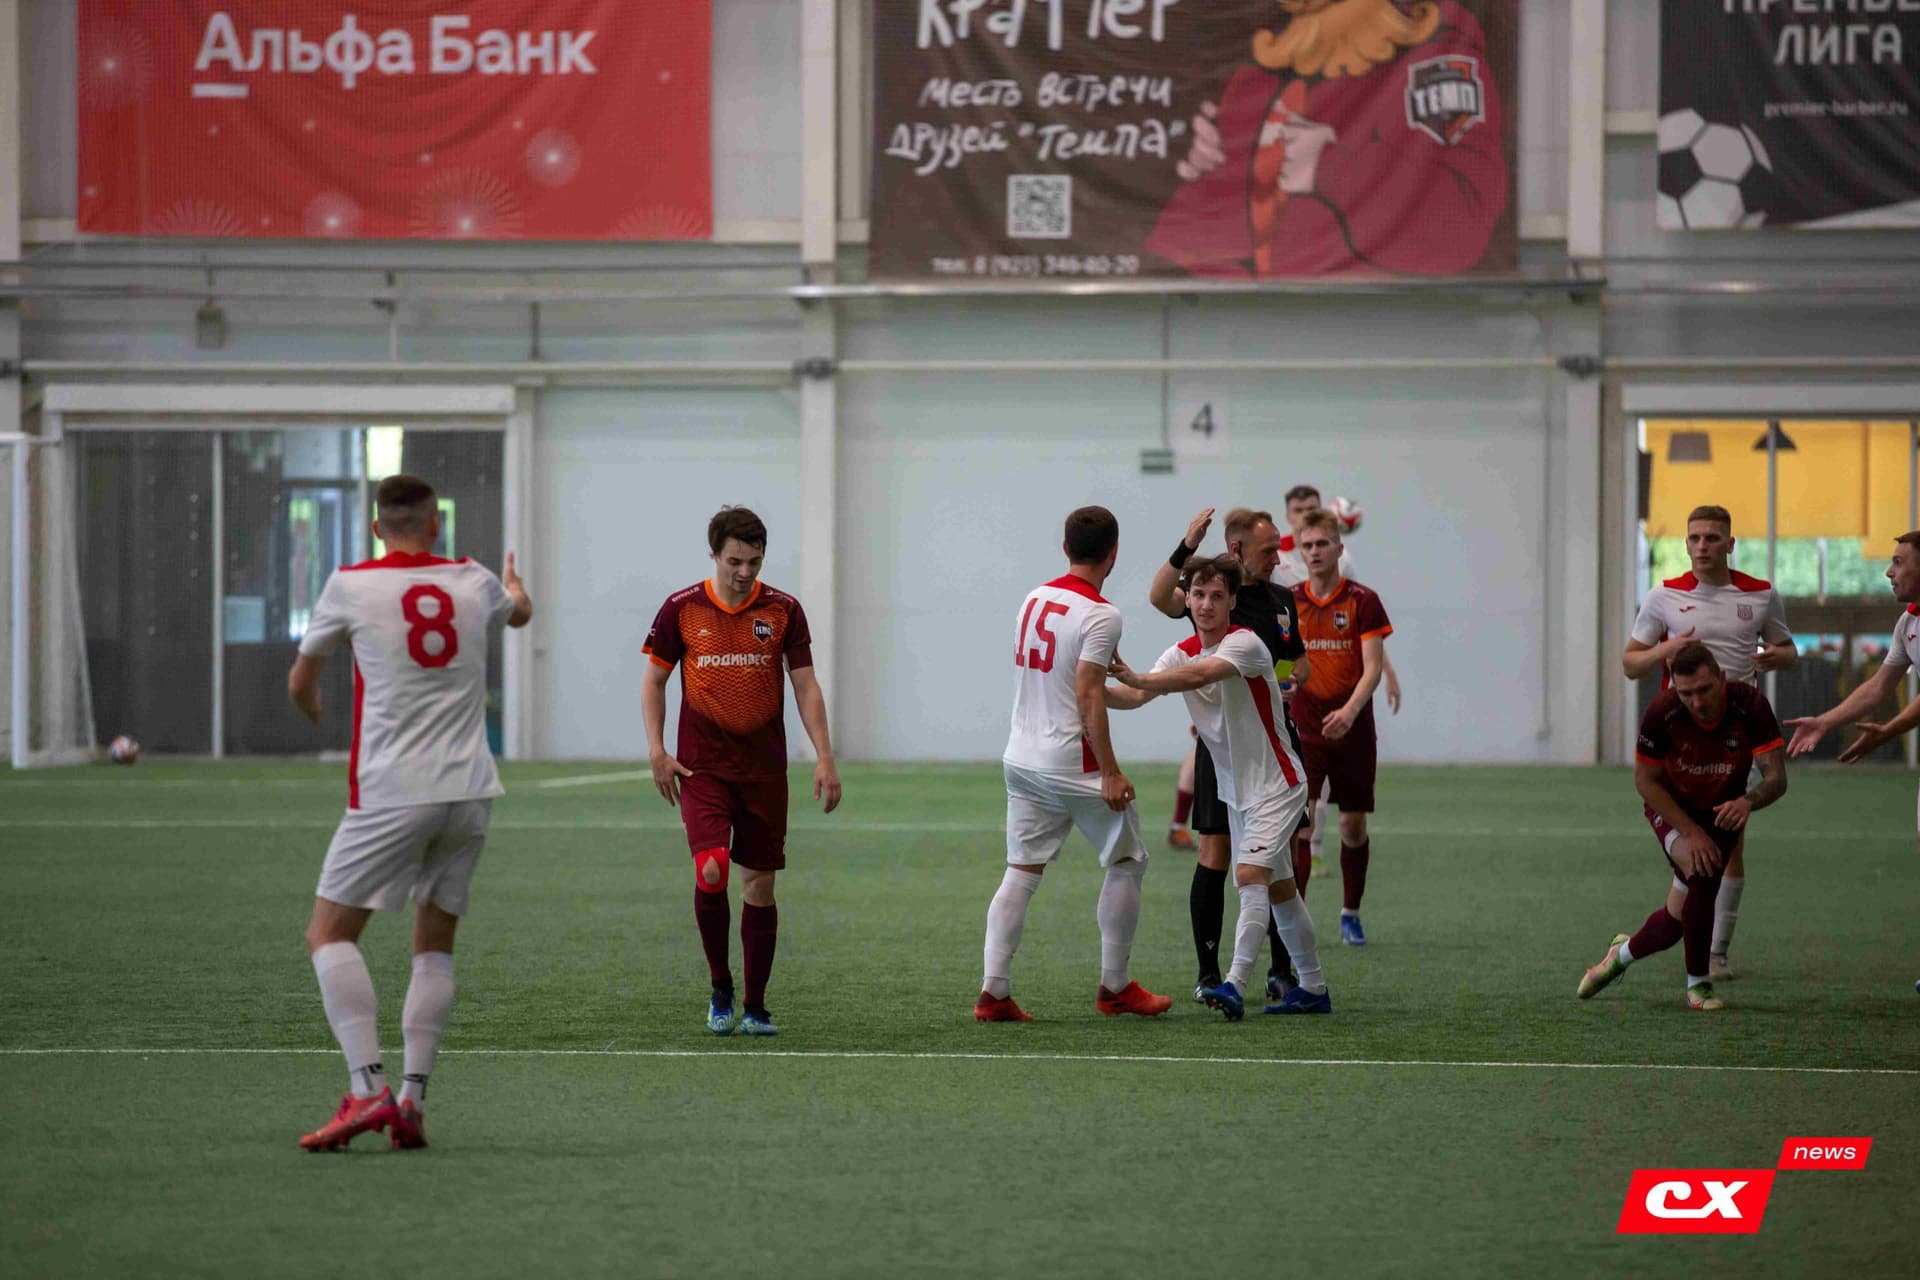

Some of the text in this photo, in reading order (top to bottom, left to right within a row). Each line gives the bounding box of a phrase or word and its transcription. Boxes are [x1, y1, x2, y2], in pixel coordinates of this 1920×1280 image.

[194, 11, 598, 90] Альфа Банк
[1773, 24, 1903, 65] ЛИГА
[1190, 402, 1213, 438] 4
[401, 583, 459, 669] 8
[1015, 597, 1071, 674] 15
